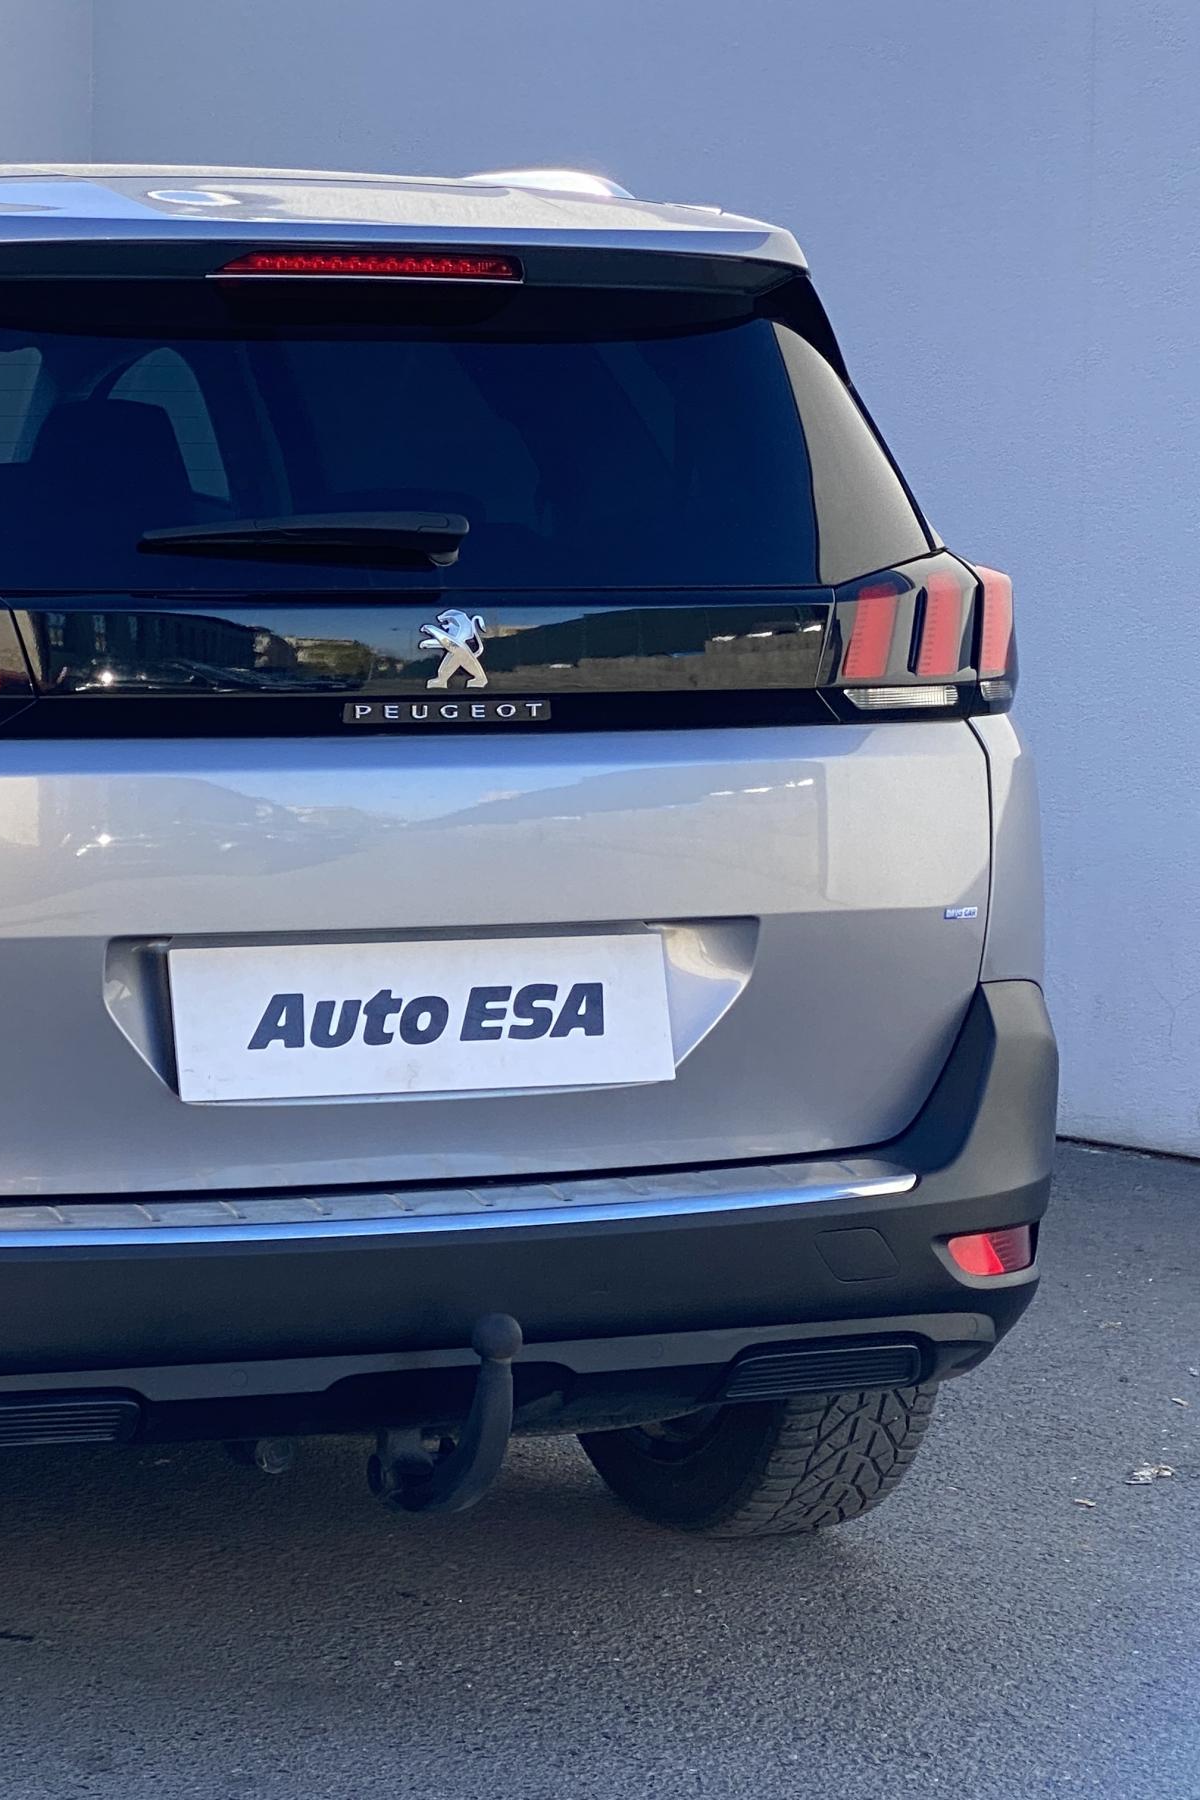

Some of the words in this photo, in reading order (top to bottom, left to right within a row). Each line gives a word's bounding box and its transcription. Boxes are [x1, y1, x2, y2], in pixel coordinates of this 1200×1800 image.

[354, 702, 543, 720] PEUGEOT
[247, 989, 450, 1050] Auto
[459, 982, 604, 1041] ESA
